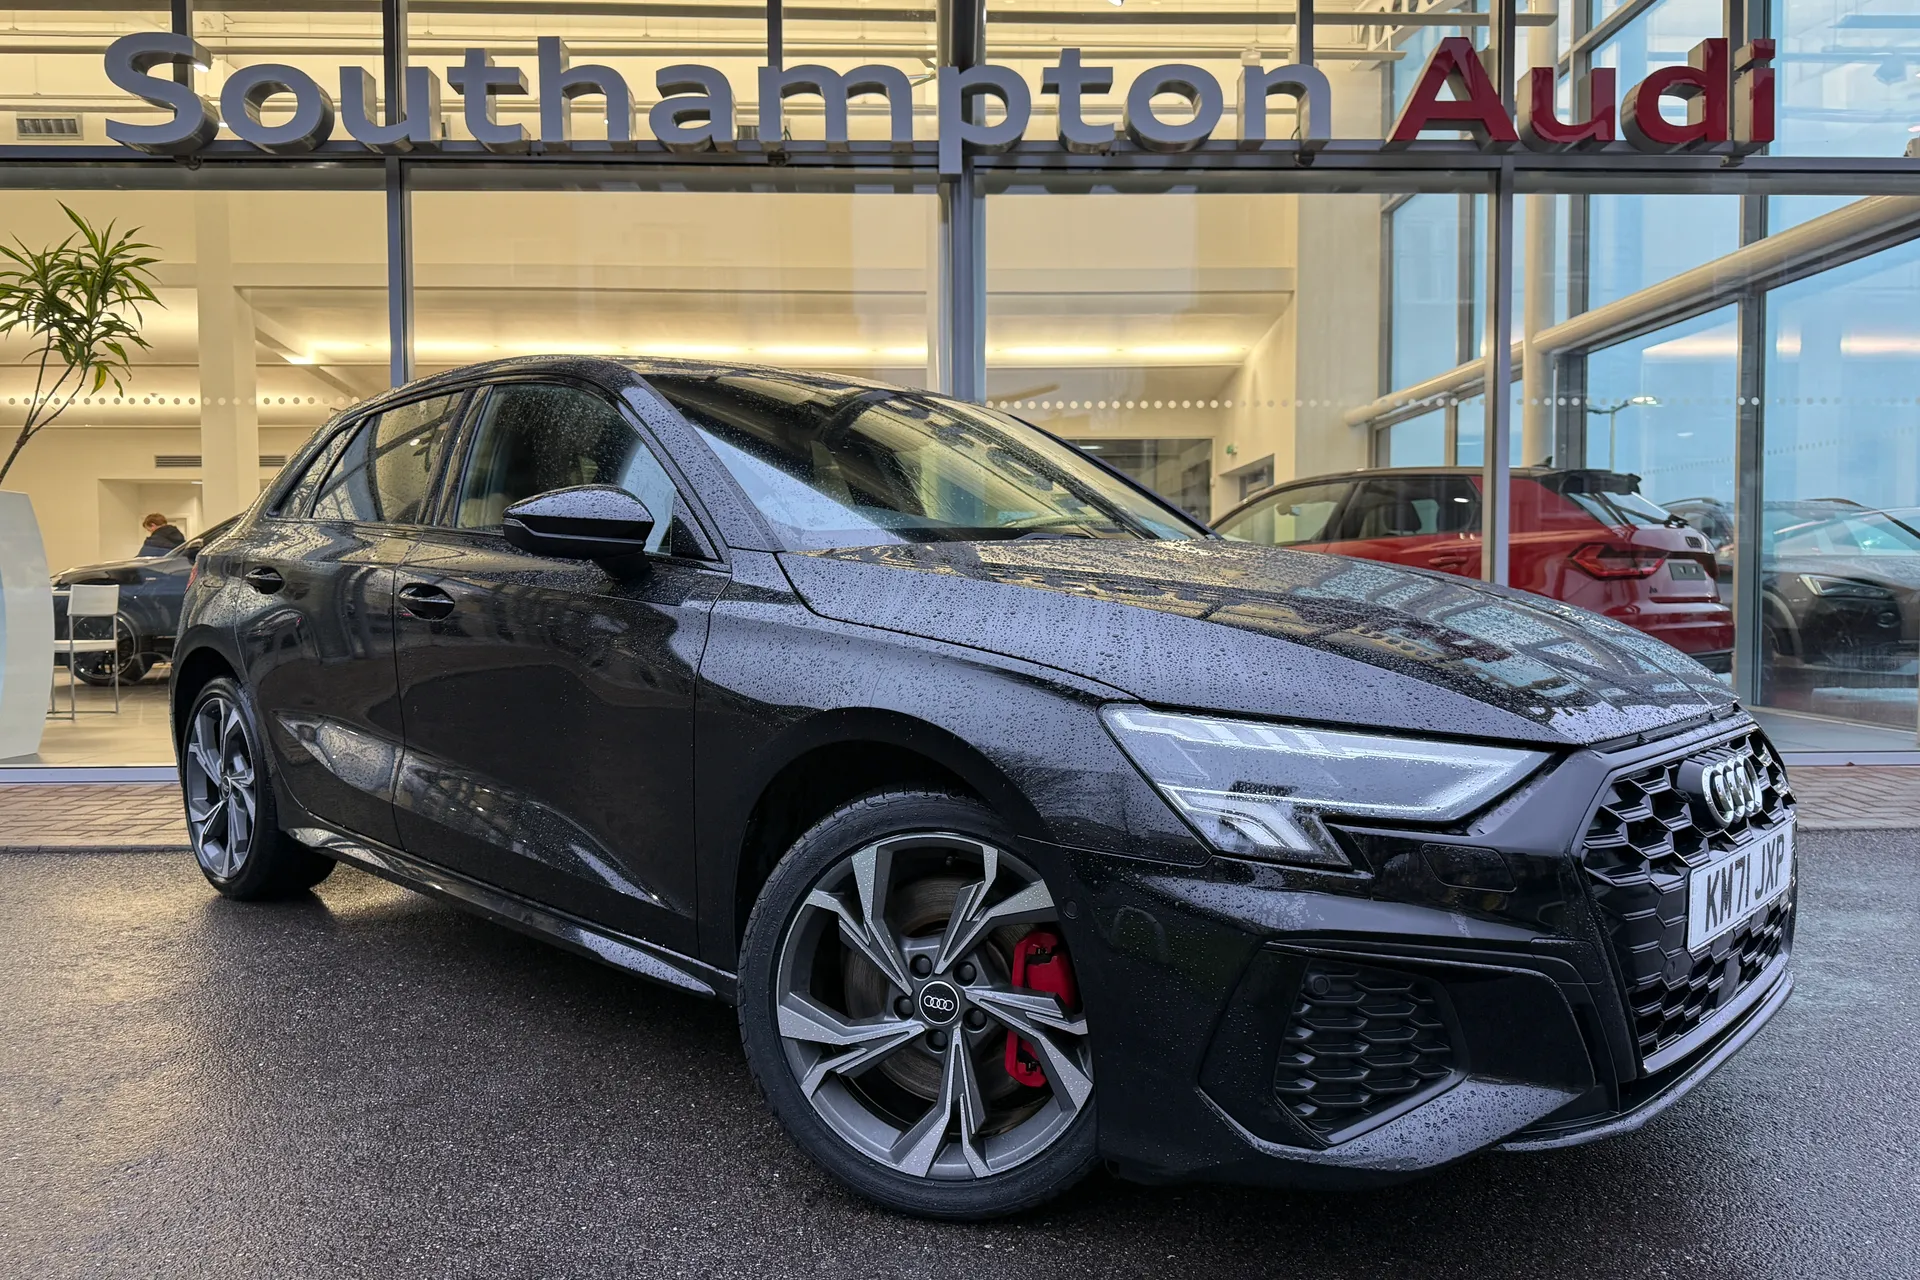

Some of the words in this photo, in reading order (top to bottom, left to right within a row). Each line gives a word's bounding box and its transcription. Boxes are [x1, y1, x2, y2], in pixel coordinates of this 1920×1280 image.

[104, 32, 1331, 178] Southampton
[1388, 36, 1776, 148] Audi
[1705, 854, 1751, 933] KM71
[1754, 833, 1785, 900] JXP
